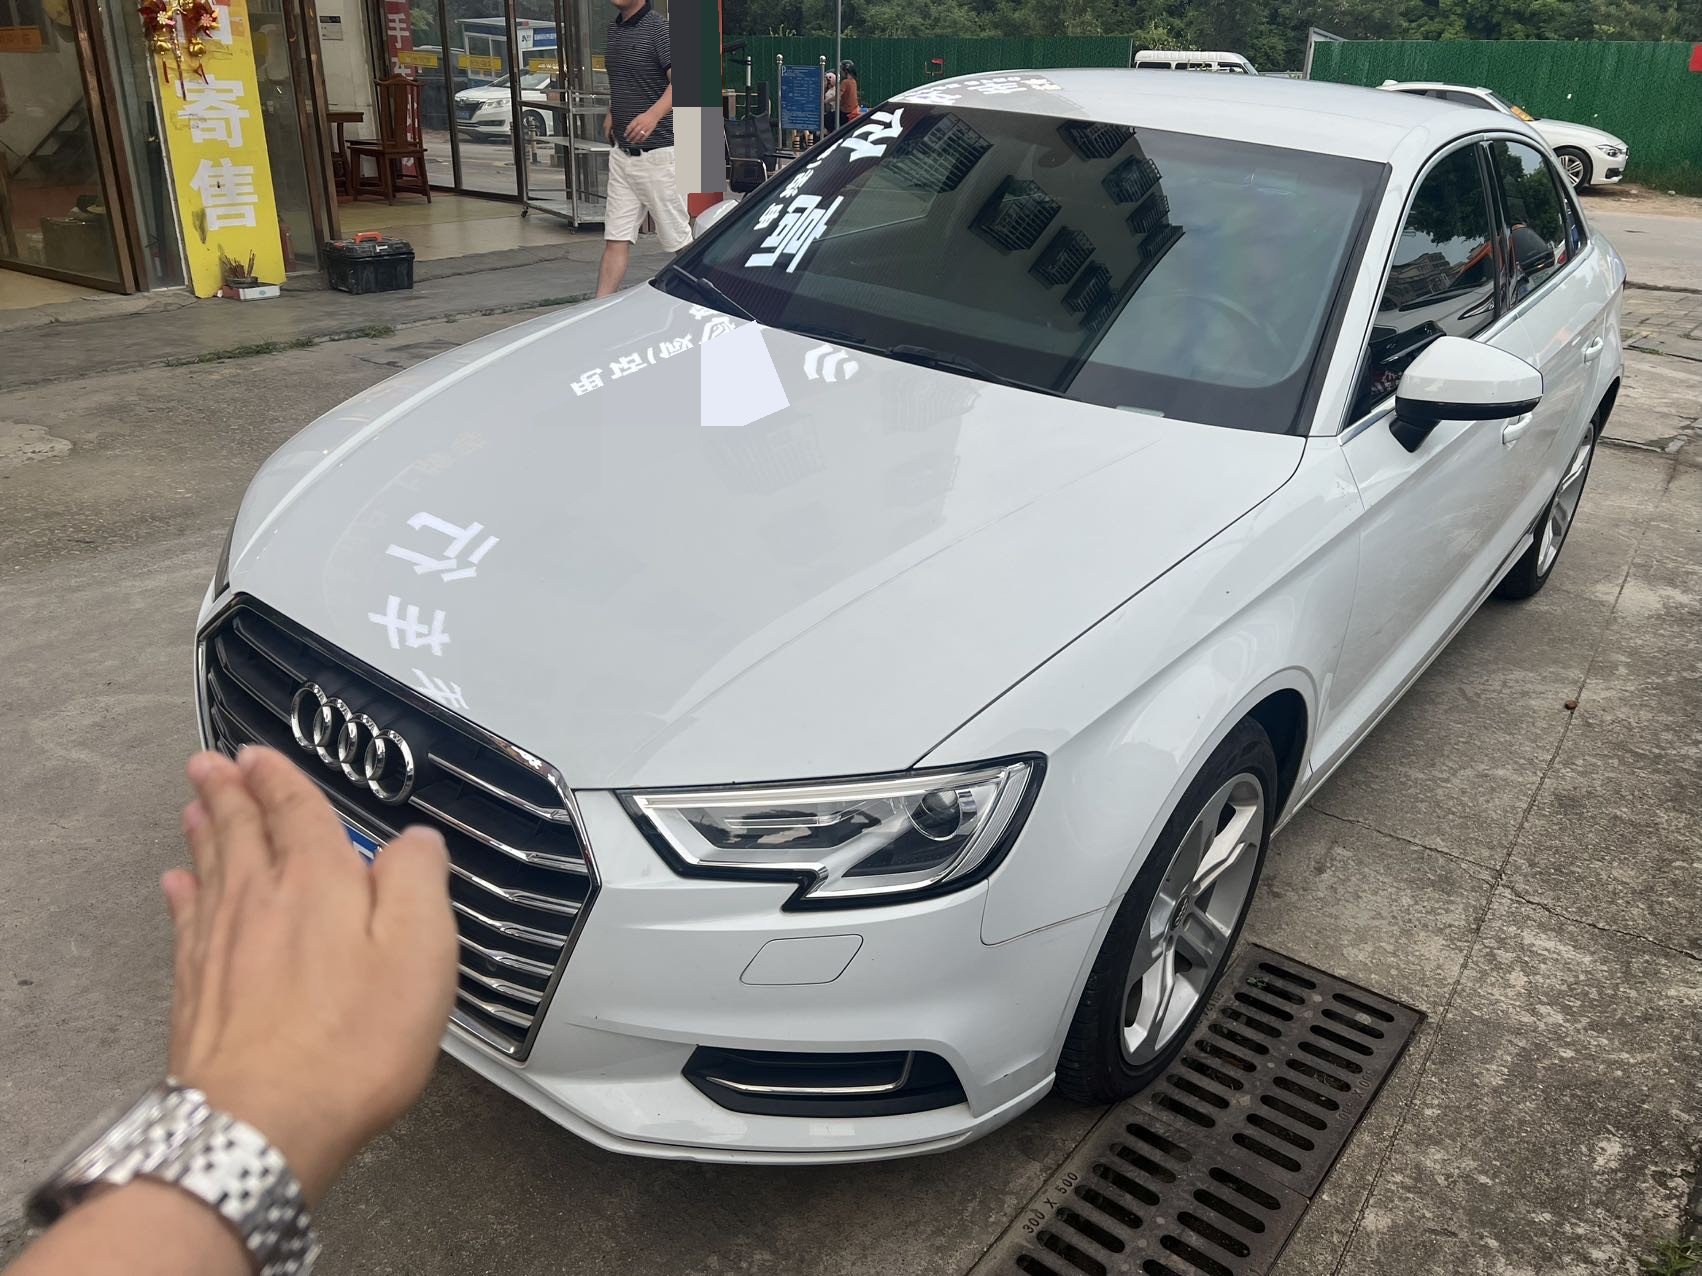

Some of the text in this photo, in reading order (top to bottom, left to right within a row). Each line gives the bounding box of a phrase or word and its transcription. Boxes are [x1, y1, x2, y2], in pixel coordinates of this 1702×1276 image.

[171, 0, 260, 232] 寄售
[1022, 1210, 1045, 1233] 300
[1055, 1172, 1078, 1194] 500
